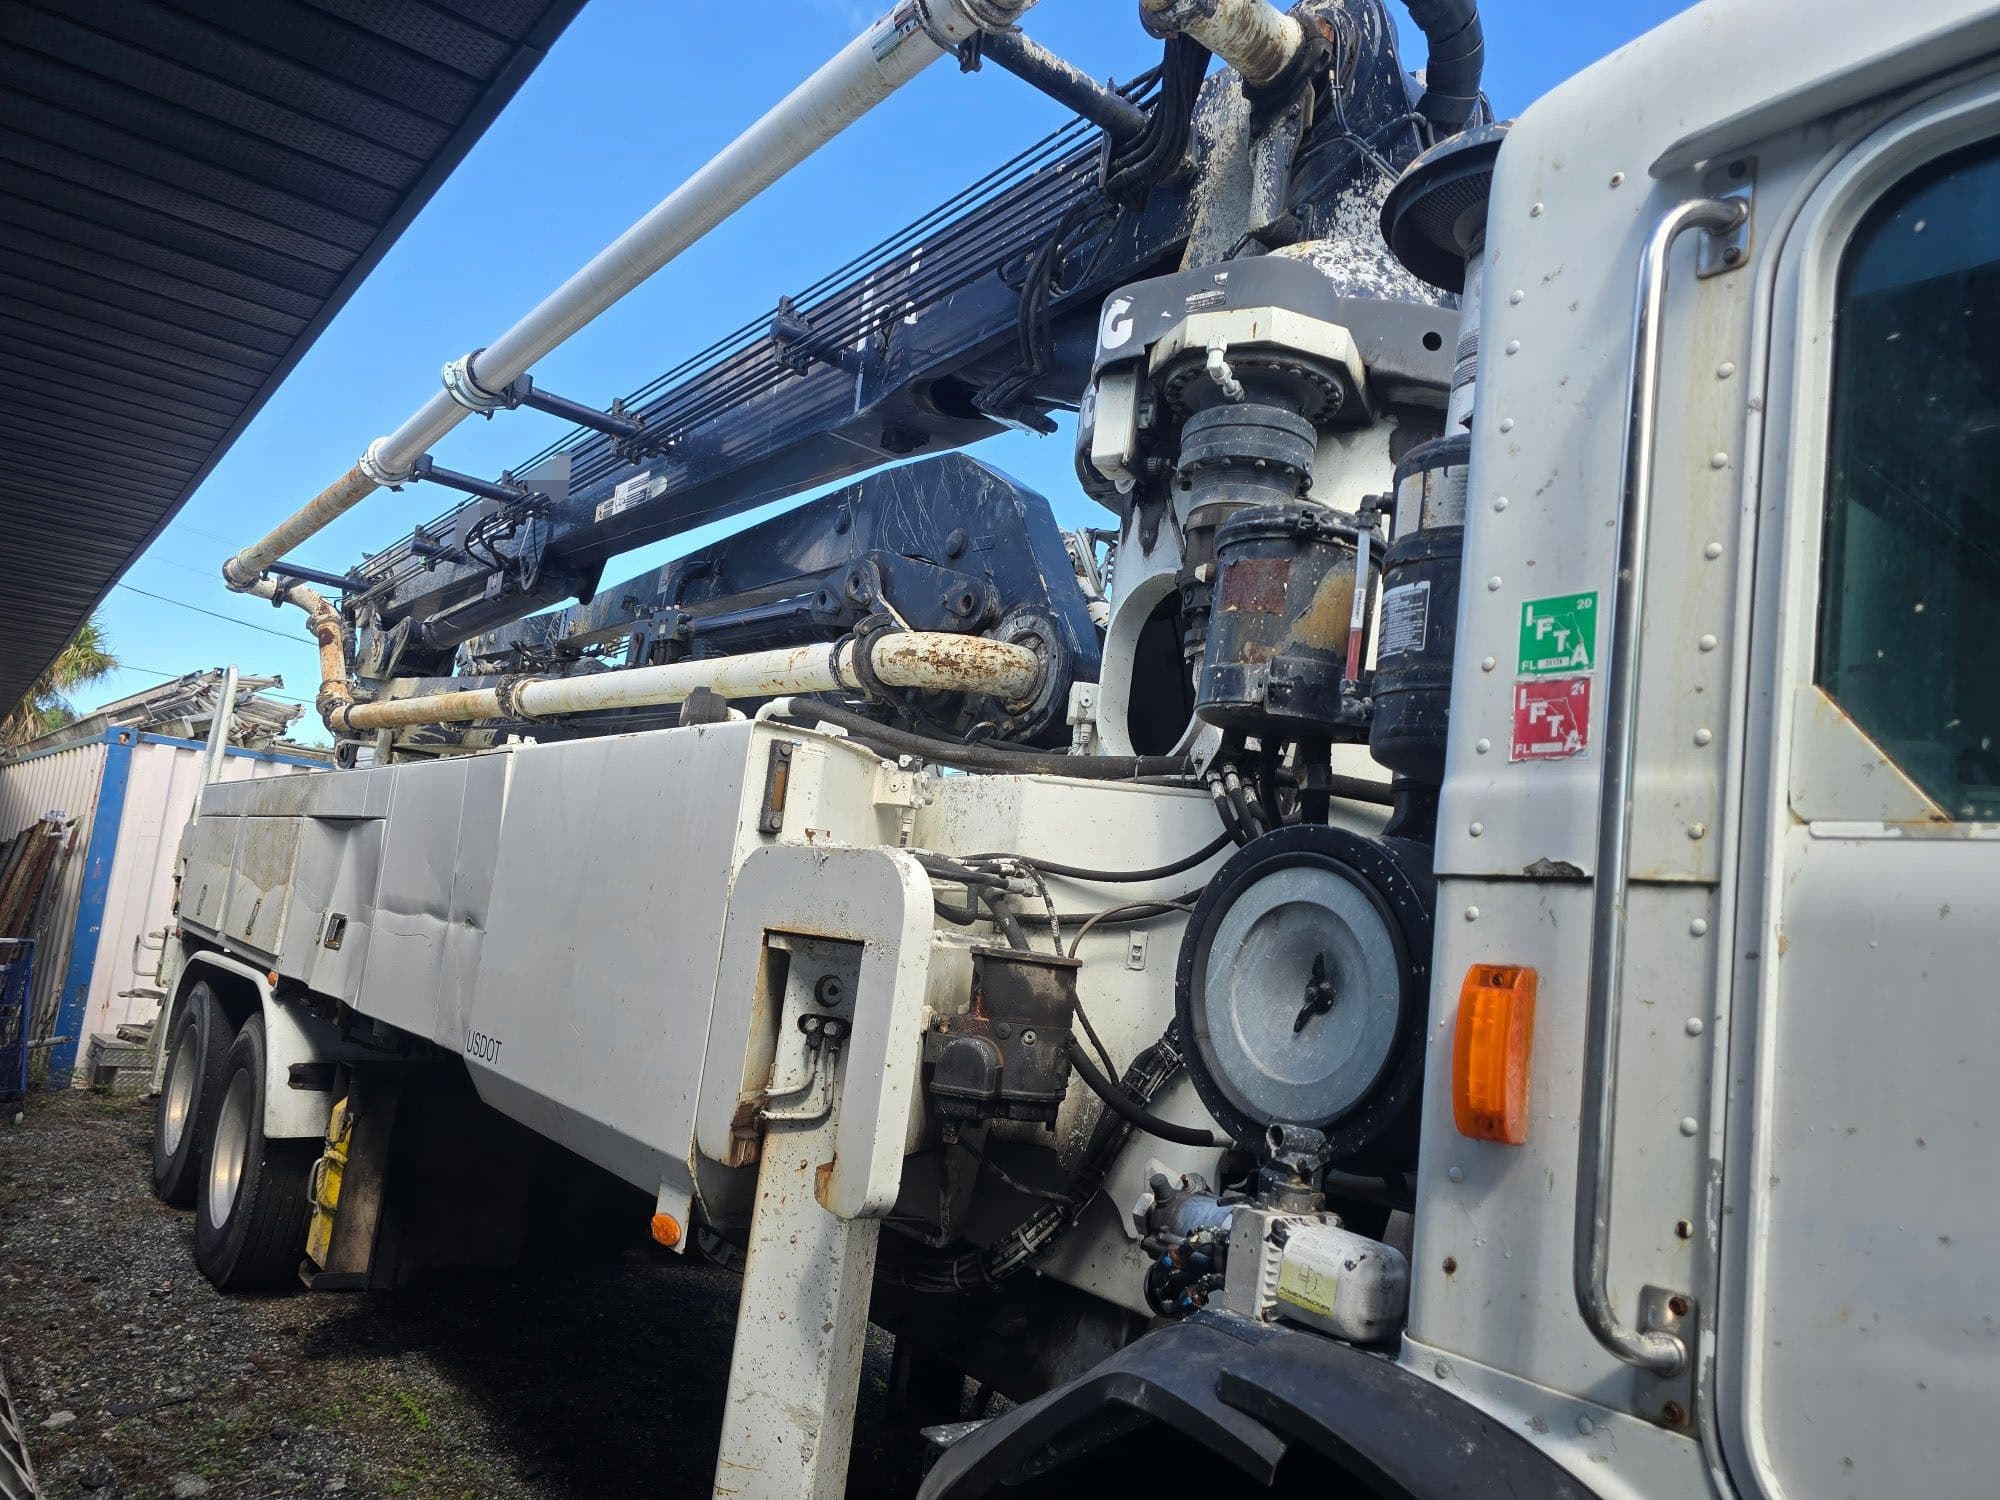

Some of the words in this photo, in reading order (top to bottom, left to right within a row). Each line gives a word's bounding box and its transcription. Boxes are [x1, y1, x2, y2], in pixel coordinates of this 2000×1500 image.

[1576, 597, 1592, 610] 20
[1521, 659, 1537, 671] FL
[1571, 680, 1584, 696] 21
[1515, 743, 1530, 755] FL
[466, 1029, 502, 1065] USDOT
